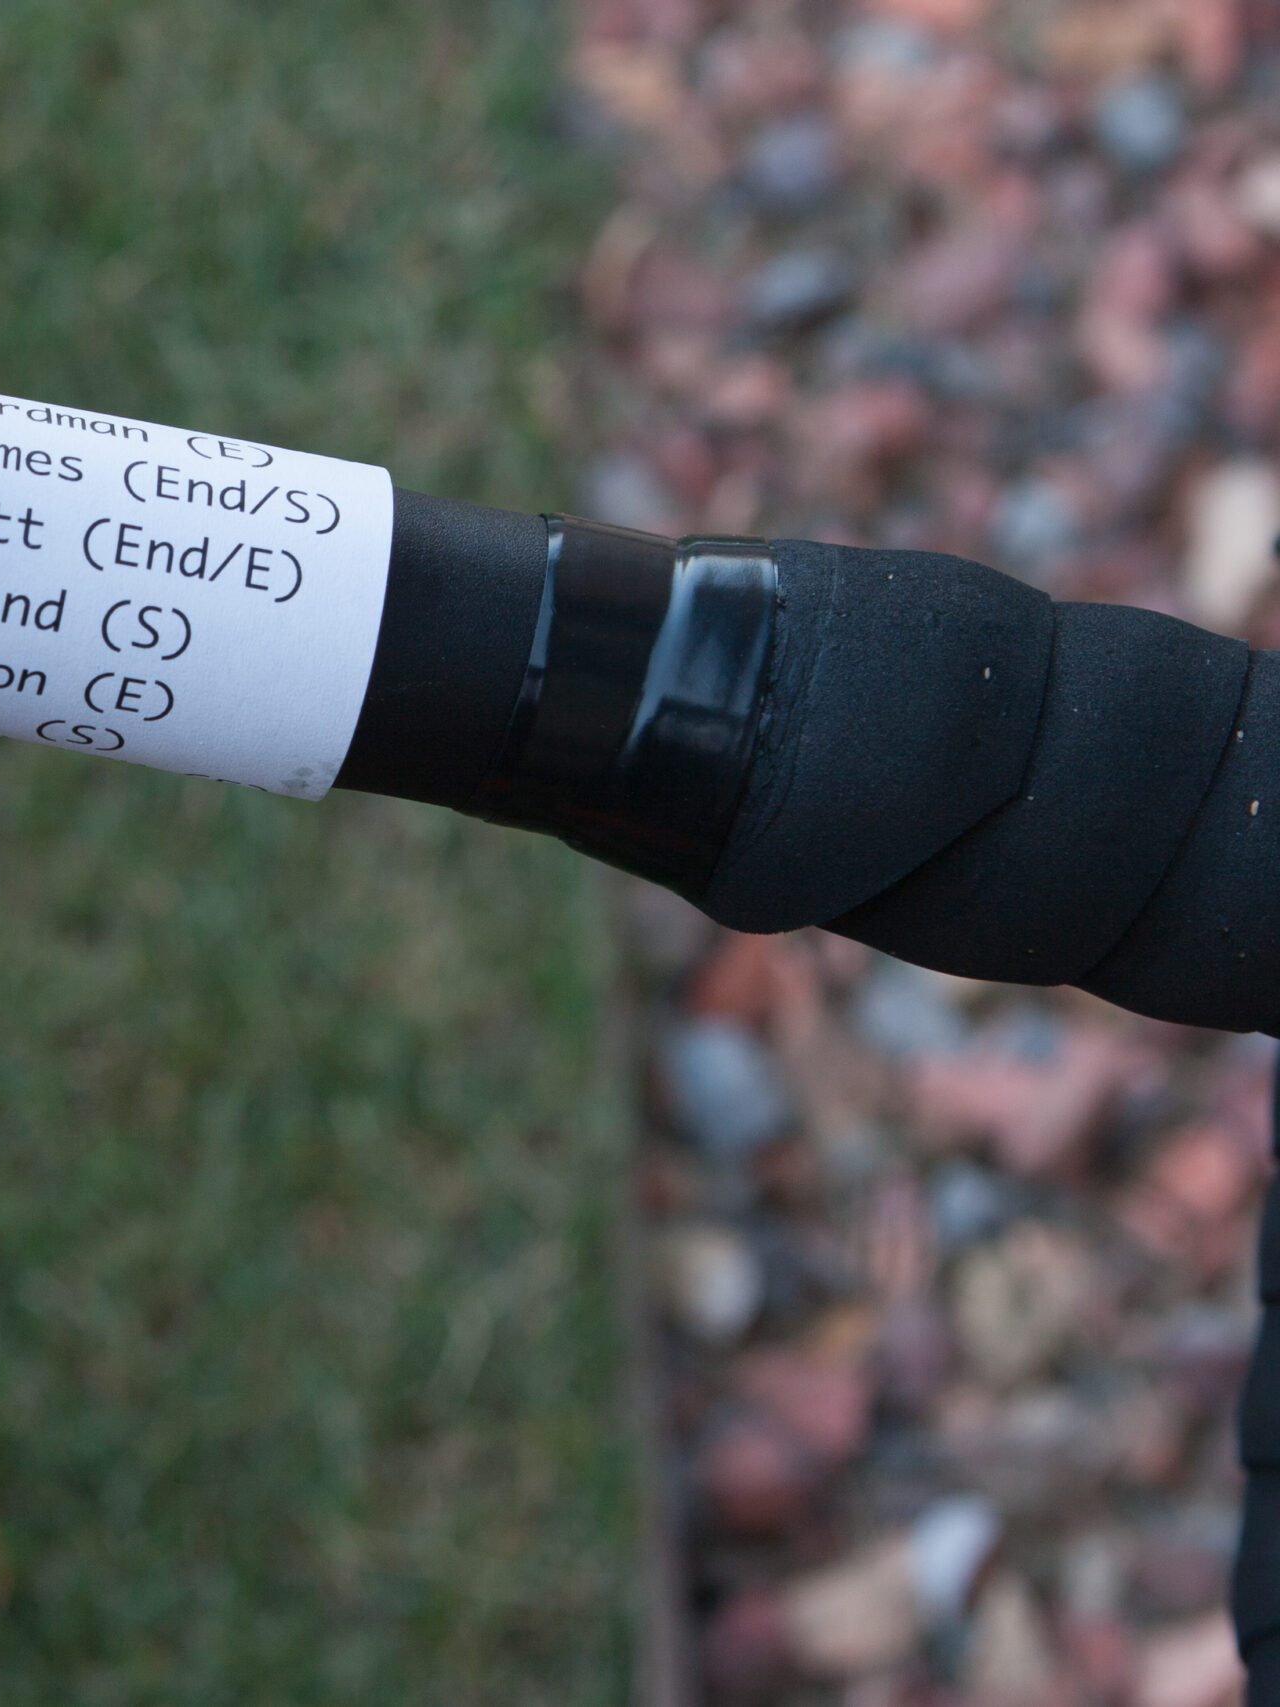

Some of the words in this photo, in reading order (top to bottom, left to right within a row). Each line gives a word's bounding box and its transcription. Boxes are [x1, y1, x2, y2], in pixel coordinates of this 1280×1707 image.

[186, 436, 274, 469] (E)
[123, 460, 341, 536] (End/S)
[82, 517, 304, 604] (End/E)
[100, 599, 193, 662] (S)
[35, 719, 125, 751] (S)
[83, 671, 175, 737] (E)
